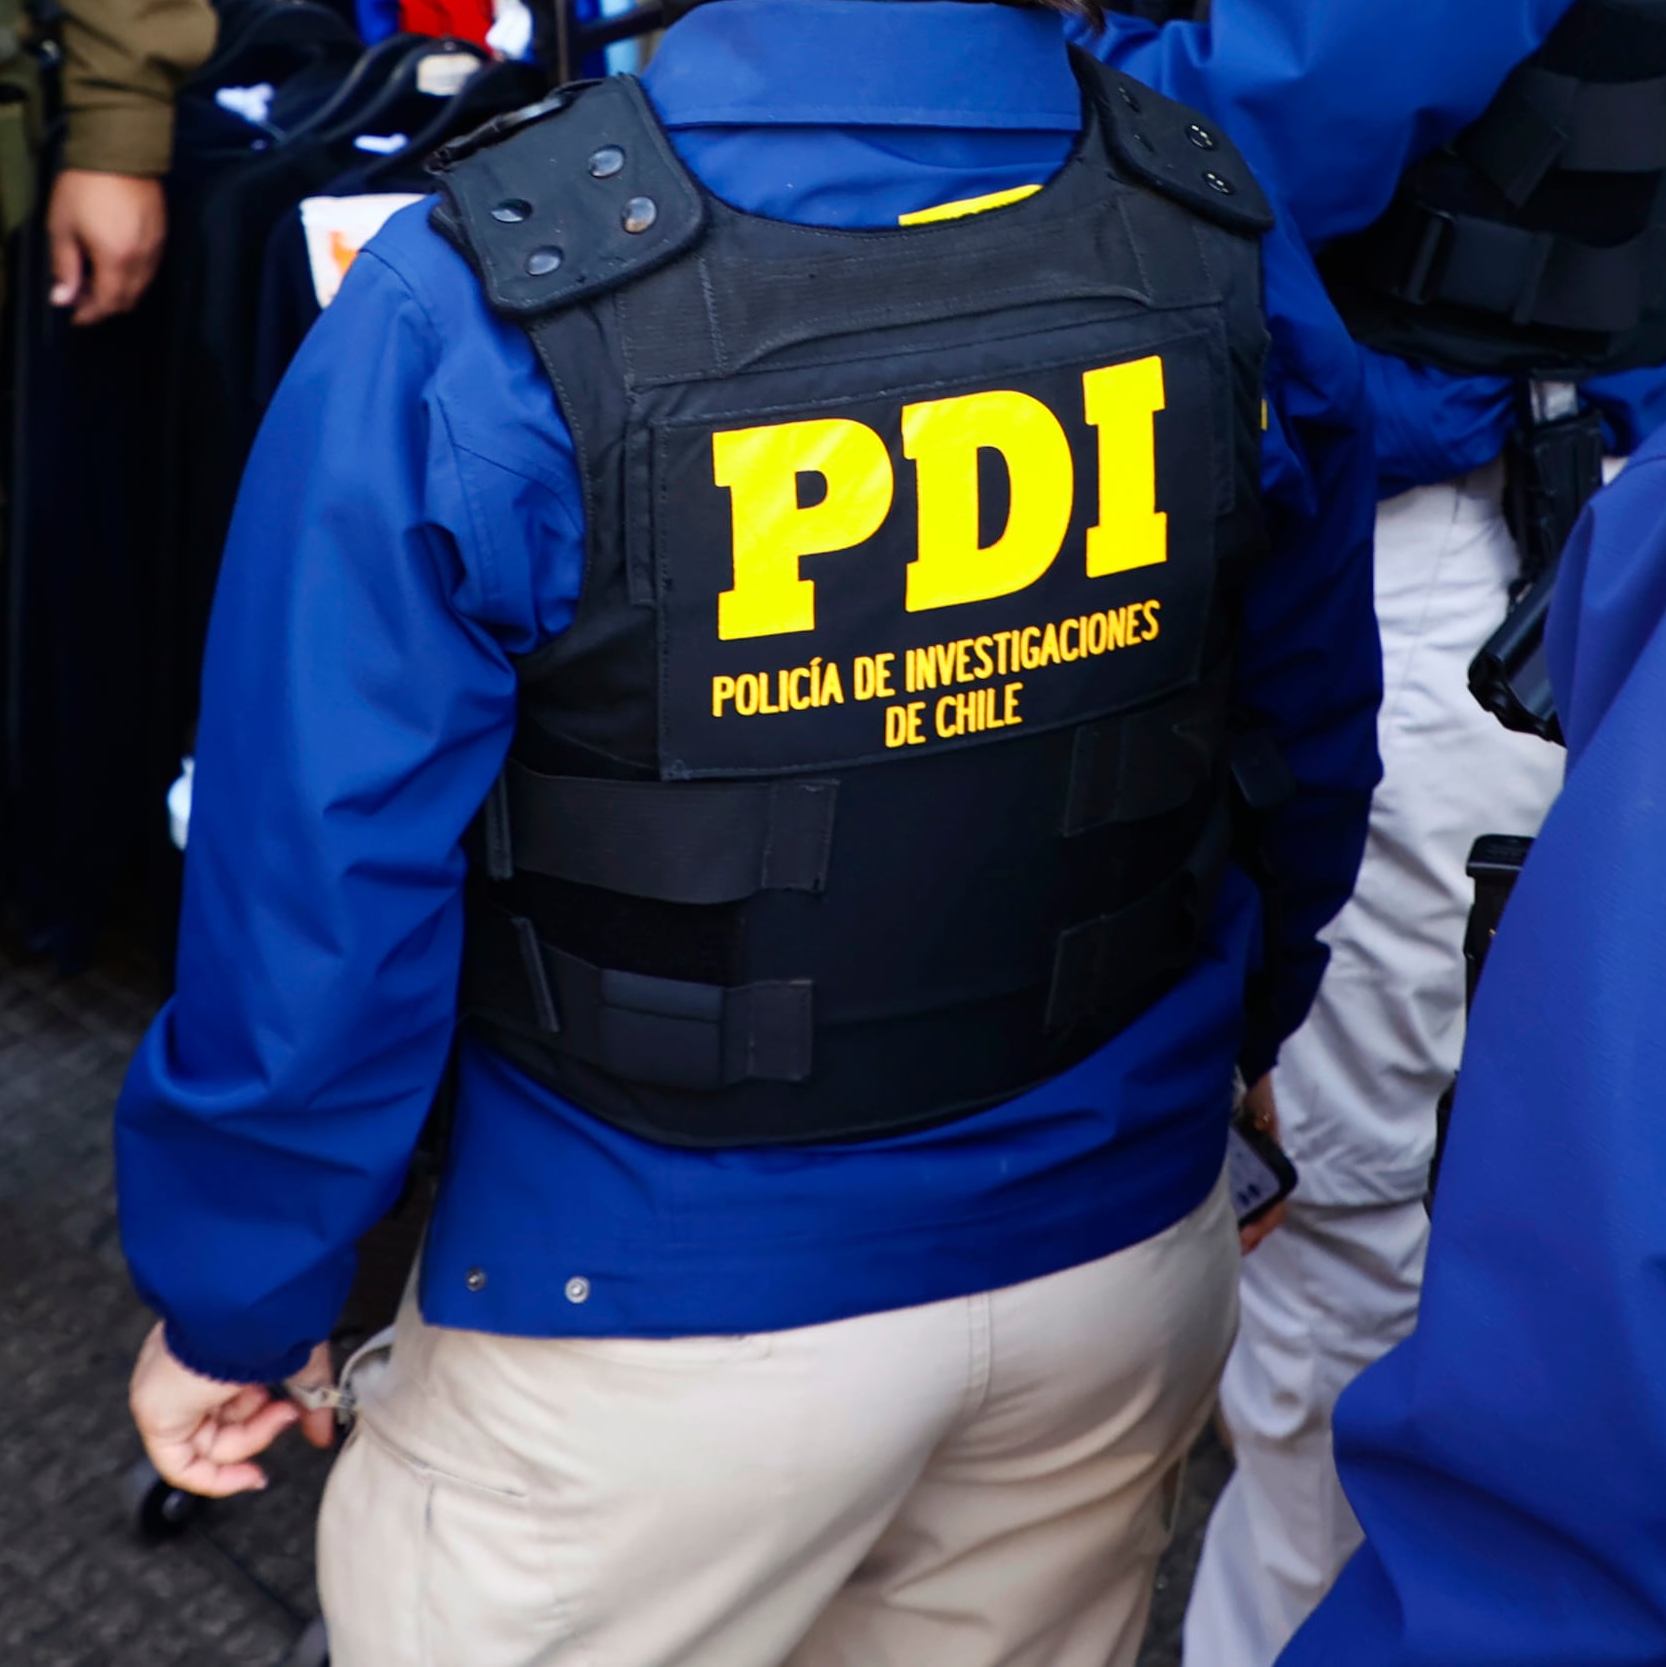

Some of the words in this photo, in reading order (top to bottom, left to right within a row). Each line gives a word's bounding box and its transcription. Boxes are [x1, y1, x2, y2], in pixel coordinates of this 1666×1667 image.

[711, 354, 1169, 641] PDI
[712, 656, 845, 718] POLICÍA
[853, 652, 896, 701] DE
[905, 599, 1161, 694] INVESTIGACIONES
[885, 700, 927, 748] DE
[935, 681, 1024, 738] CHILE
